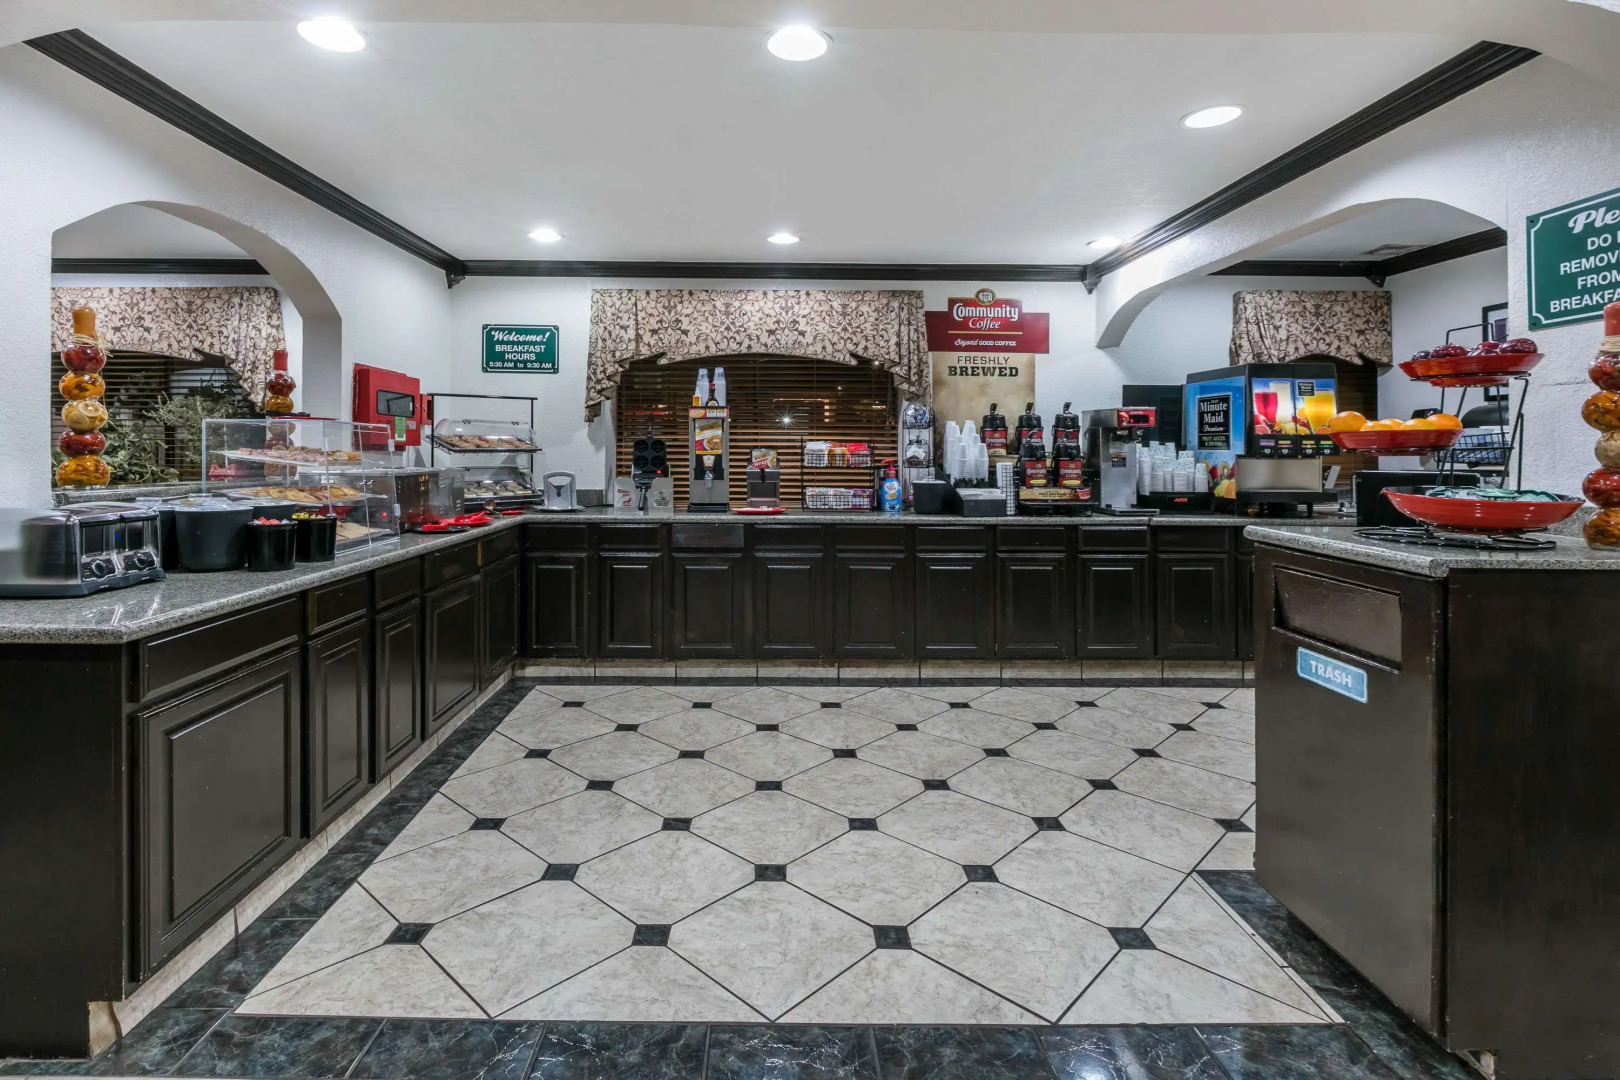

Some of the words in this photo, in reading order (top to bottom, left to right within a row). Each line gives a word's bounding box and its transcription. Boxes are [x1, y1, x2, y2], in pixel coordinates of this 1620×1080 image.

[1587, 233, 1612, 251] DO
[1560, 249, 1620, 275] REMOV
[953, 303, 1019, 321] Community
[968, 318, 1001, 331] Coffee
[491, 331, 551, 342] Welcome!
[495, 344, 546, 352] BREAKFAST
[957, 356, 1010, 365] FRESHLY
[947, 366, 1019, 377] BREWED
[1200, 401, 1228, 412] Minute
[1203, 412, 1224, 424] Maid
[1310, 660, 1352, 688] TRASH
